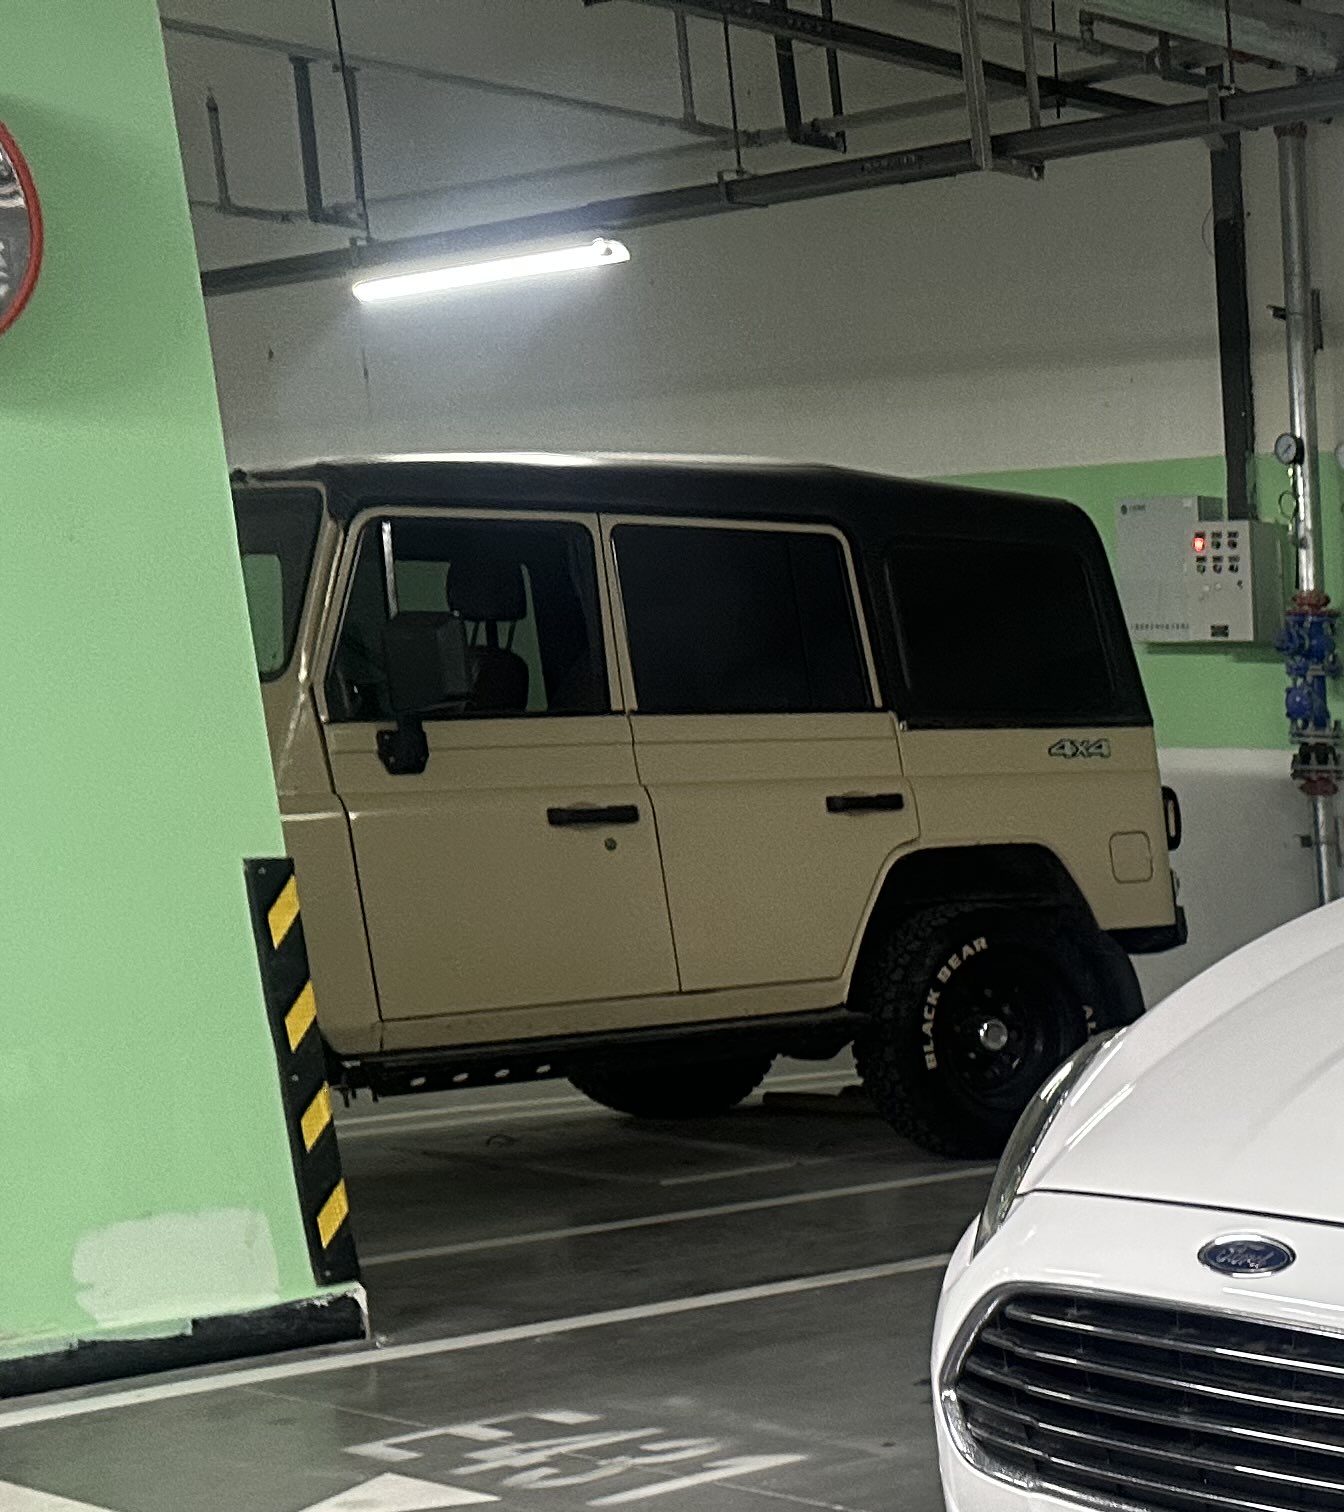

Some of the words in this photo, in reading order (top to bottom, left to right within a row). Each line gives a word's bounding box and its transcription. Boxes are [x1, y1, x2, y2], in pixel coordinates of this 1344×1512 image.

[921, 987, 941, 1070] BLACK
[937, 936, 988, 984] BEAR
[1216, 1244, 1275, 1267] Ford
